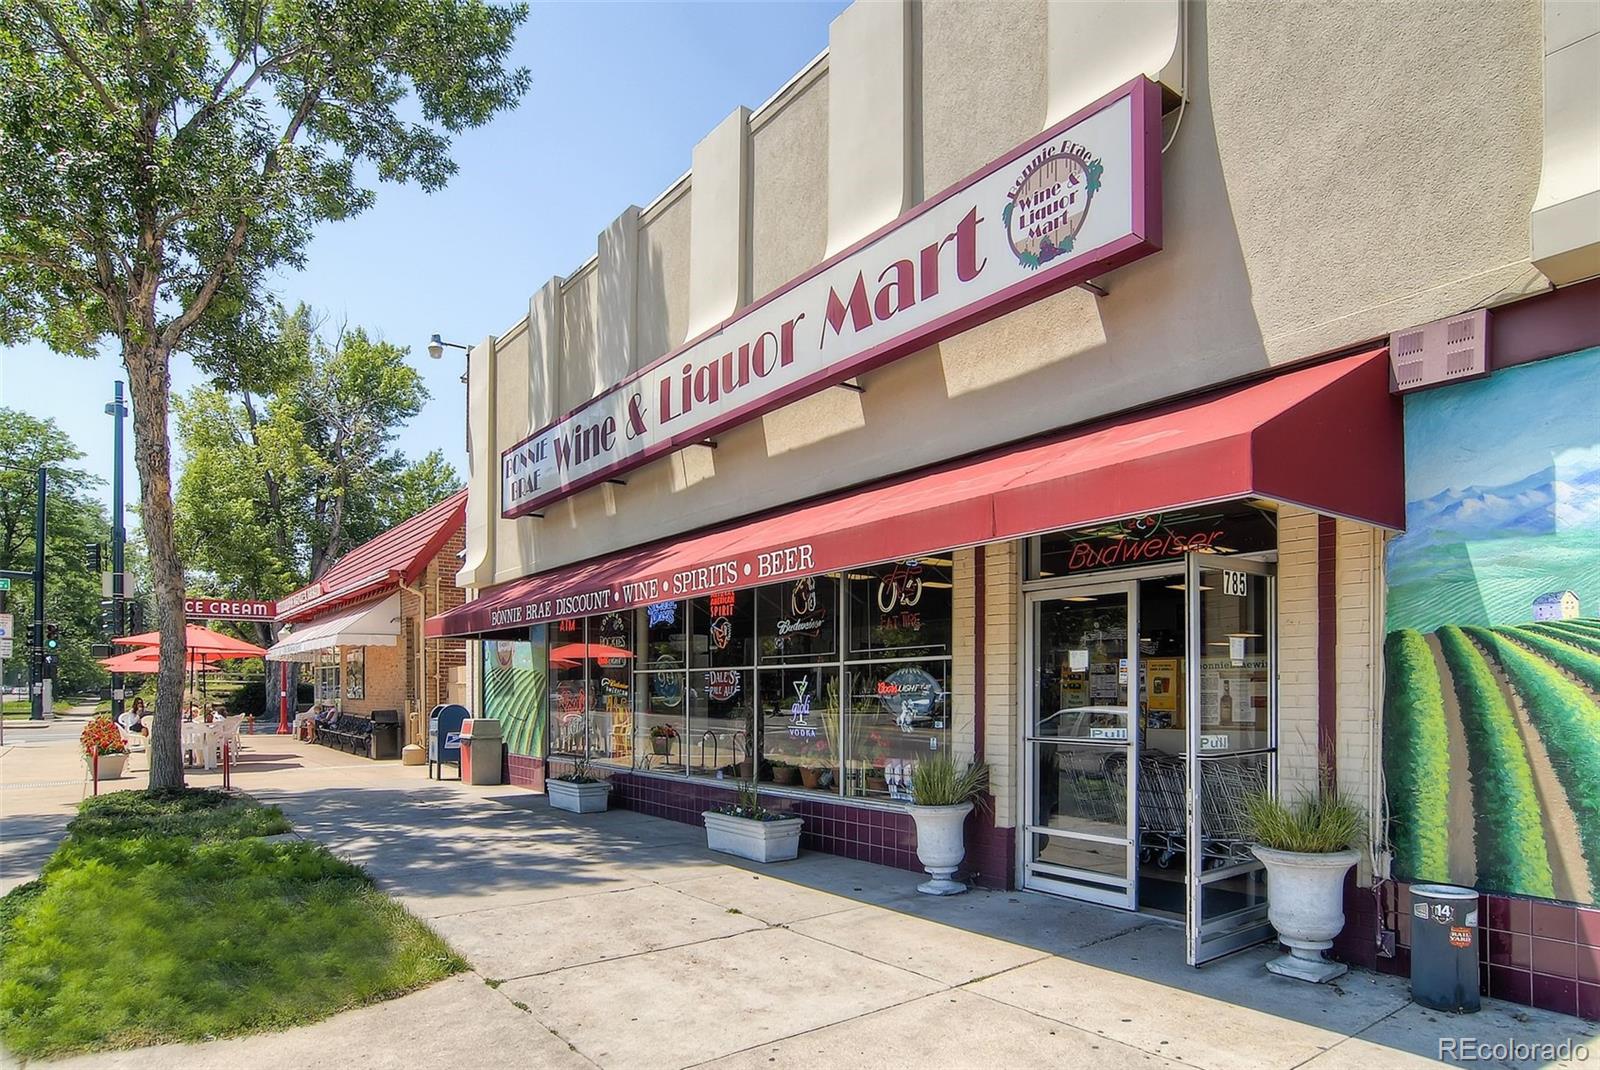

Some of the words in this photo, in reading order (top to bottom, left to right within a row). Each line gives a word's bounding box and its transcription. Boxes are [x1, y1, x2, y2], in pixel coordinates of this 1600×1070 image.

[1007, 145, 1056, 200] Bonnie
[1060, 140, 1092, 163] Brae
[1018, 183, 1062, 212] Wine
[1067, 171, 1081, 190] &
[1019, 189, 1079, 230] Liquor
[1028, 209, 1069, 239] Mart
[553, 416, 617, 476] Wine
[626, 392, 648, 441] &
[660, 312, 806, 425] Liquor
[819, 205, 988, 351] Mart
[505, 437, 549, 480] BONNIE
[511, 468, 542, 502] BRAE
[1068, 530, 1224, 569] Budweiser
[491, 608, 522, 626] BONNIE
[525, 600, 552, 621] BRAE
[556, 589, 611, 616] DISCOUNT
[622, 578, 659, 604] WINE
[673, 560, 738, 595] SPIRITS
[757, 543, 815, 579] BEER
[1225, 572, 1246, 595] 785
[184, 600, 204, 613] CE
[209, 602, 268, 616] CREAM
[710, 604, 734, 618] SPIRIT
[559, 619, 576, 633] ATM
[776, 619, 825, 635] Budweiser
[789, 728, 816, 738] VODKA
[1092, 728, 1127, 739] Pull
[1201, 737, 1228, 749] Pull
